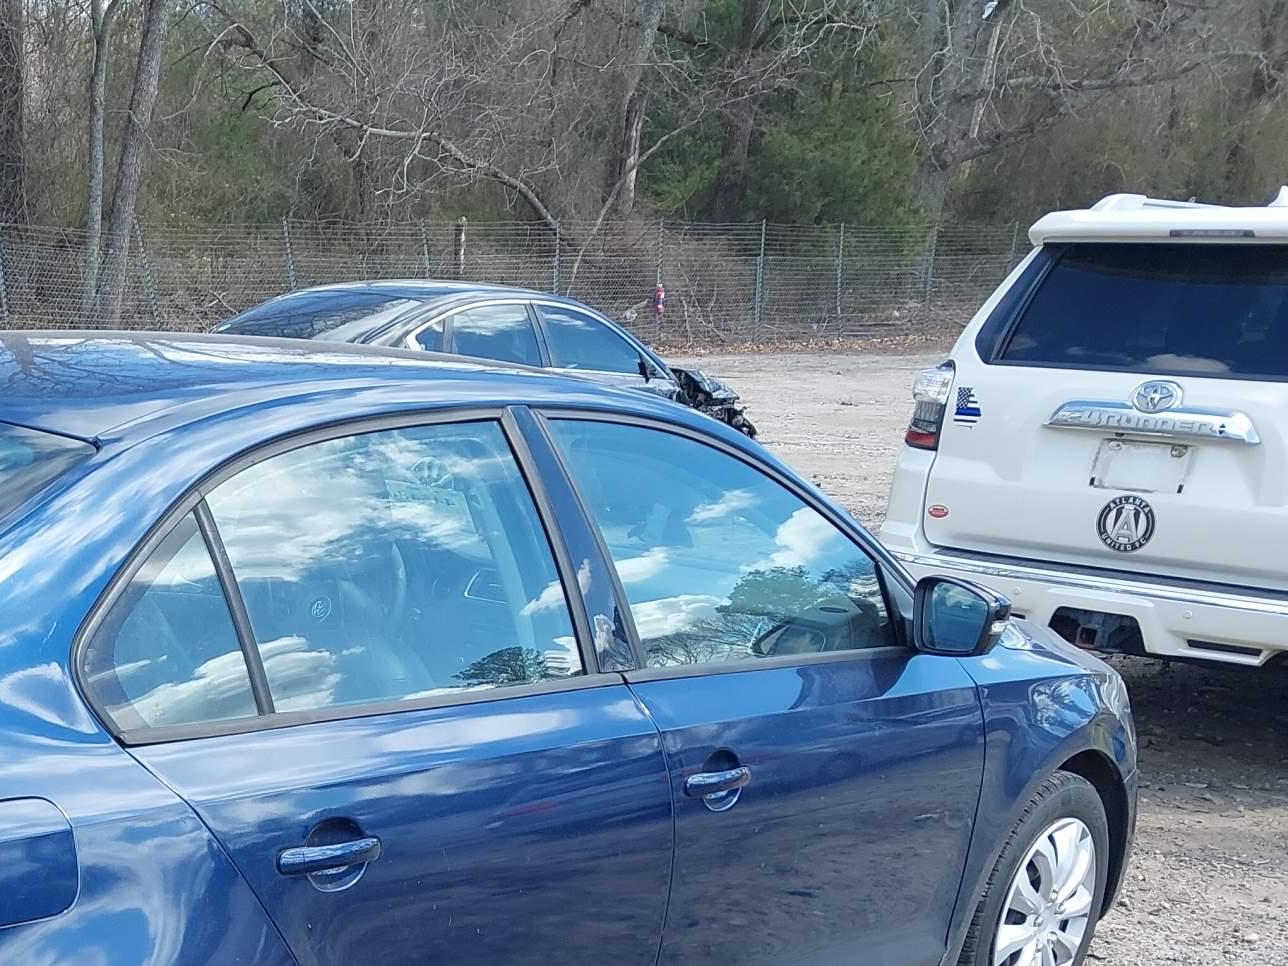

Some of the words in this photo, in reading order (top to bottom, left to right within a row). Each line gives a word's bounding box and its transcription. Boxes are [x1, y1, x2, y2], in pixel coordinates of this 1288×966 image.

[1110, 497, 1150, 512] ATLANTA
[1102, 532, 1132, 551] UNITED
[1134, 538, 1147, 548] FC
